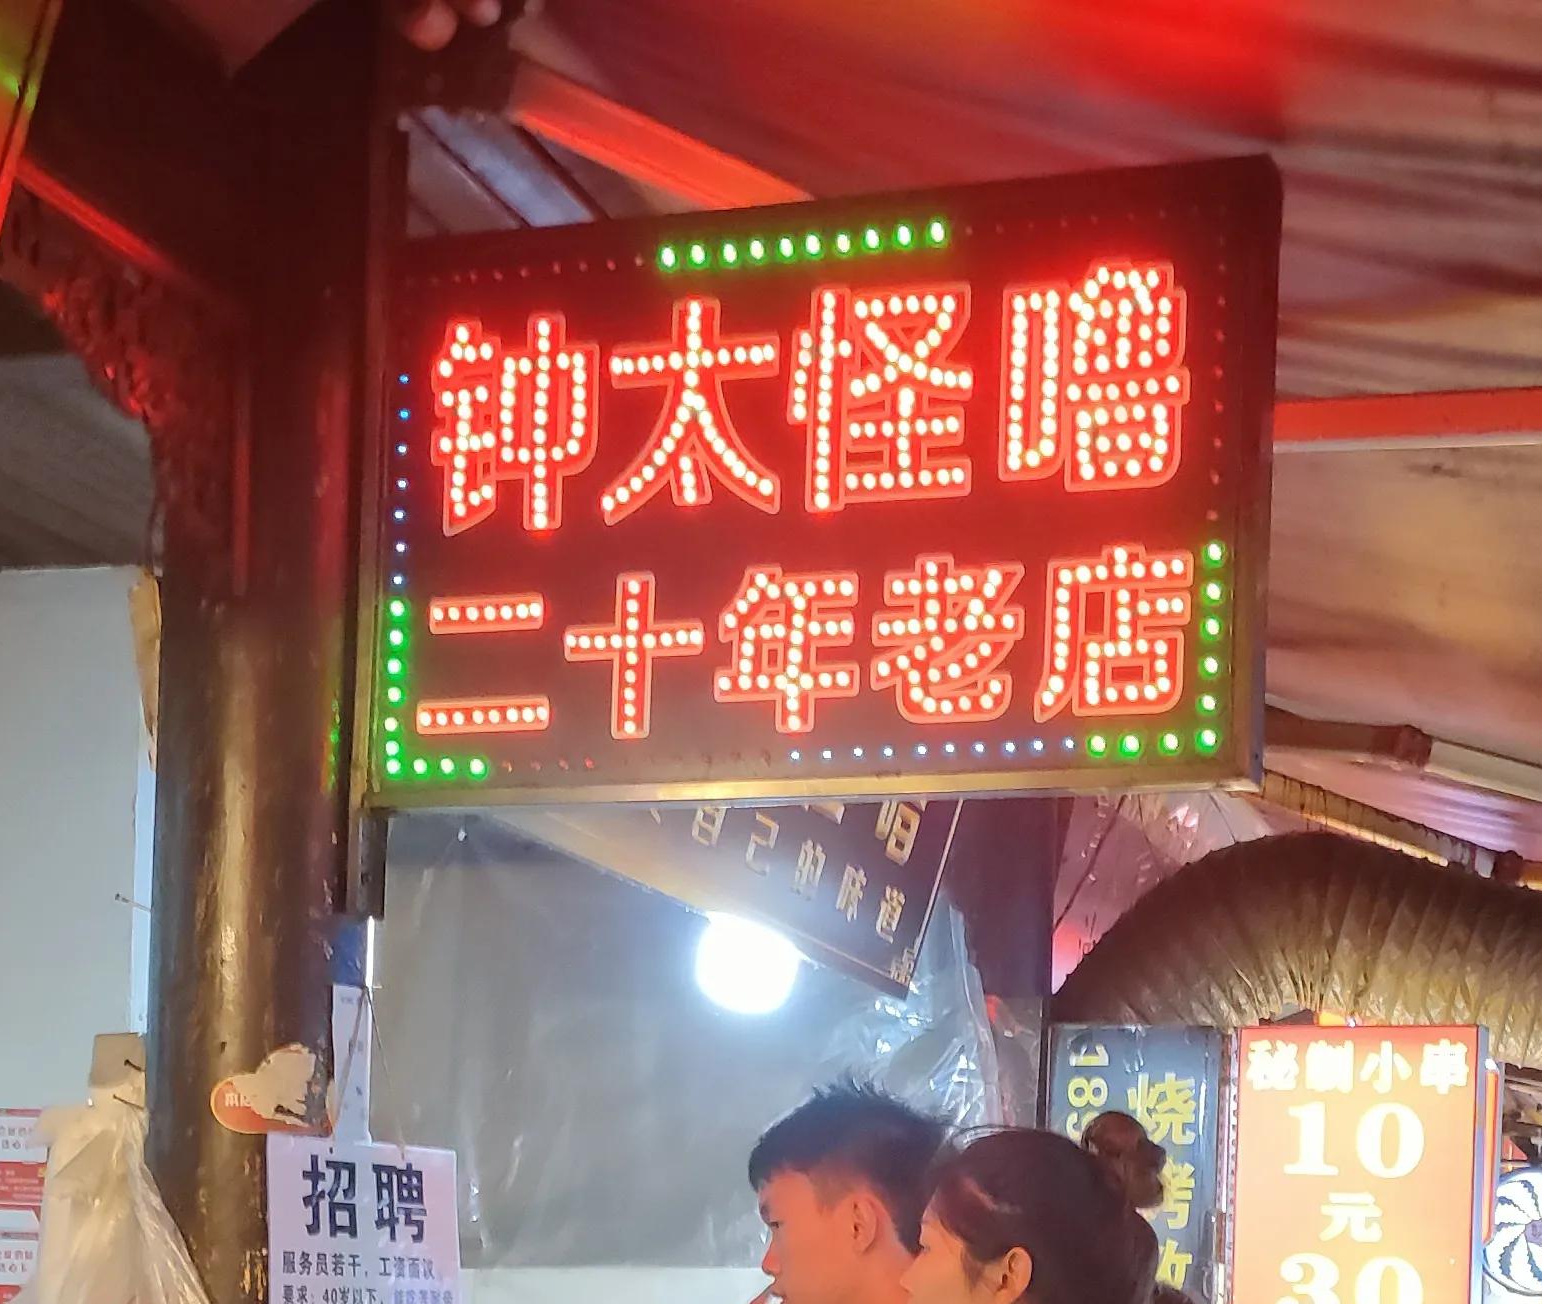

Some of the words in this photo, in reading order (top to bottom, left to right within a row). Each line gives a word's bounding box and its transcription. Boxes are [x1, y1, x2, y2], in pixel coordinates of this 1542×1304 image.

[430, 262, 1191, 537] 钟太怪噜
[414, 543, 1194, 740] 二十年老店
[691, 806, 906, 944] 自己的味道
[1282, 1101, 1425, 1179] 10
[302, 1154, 427, 1243] 招聘
[1319, 1192, 1382, 1243] 元
